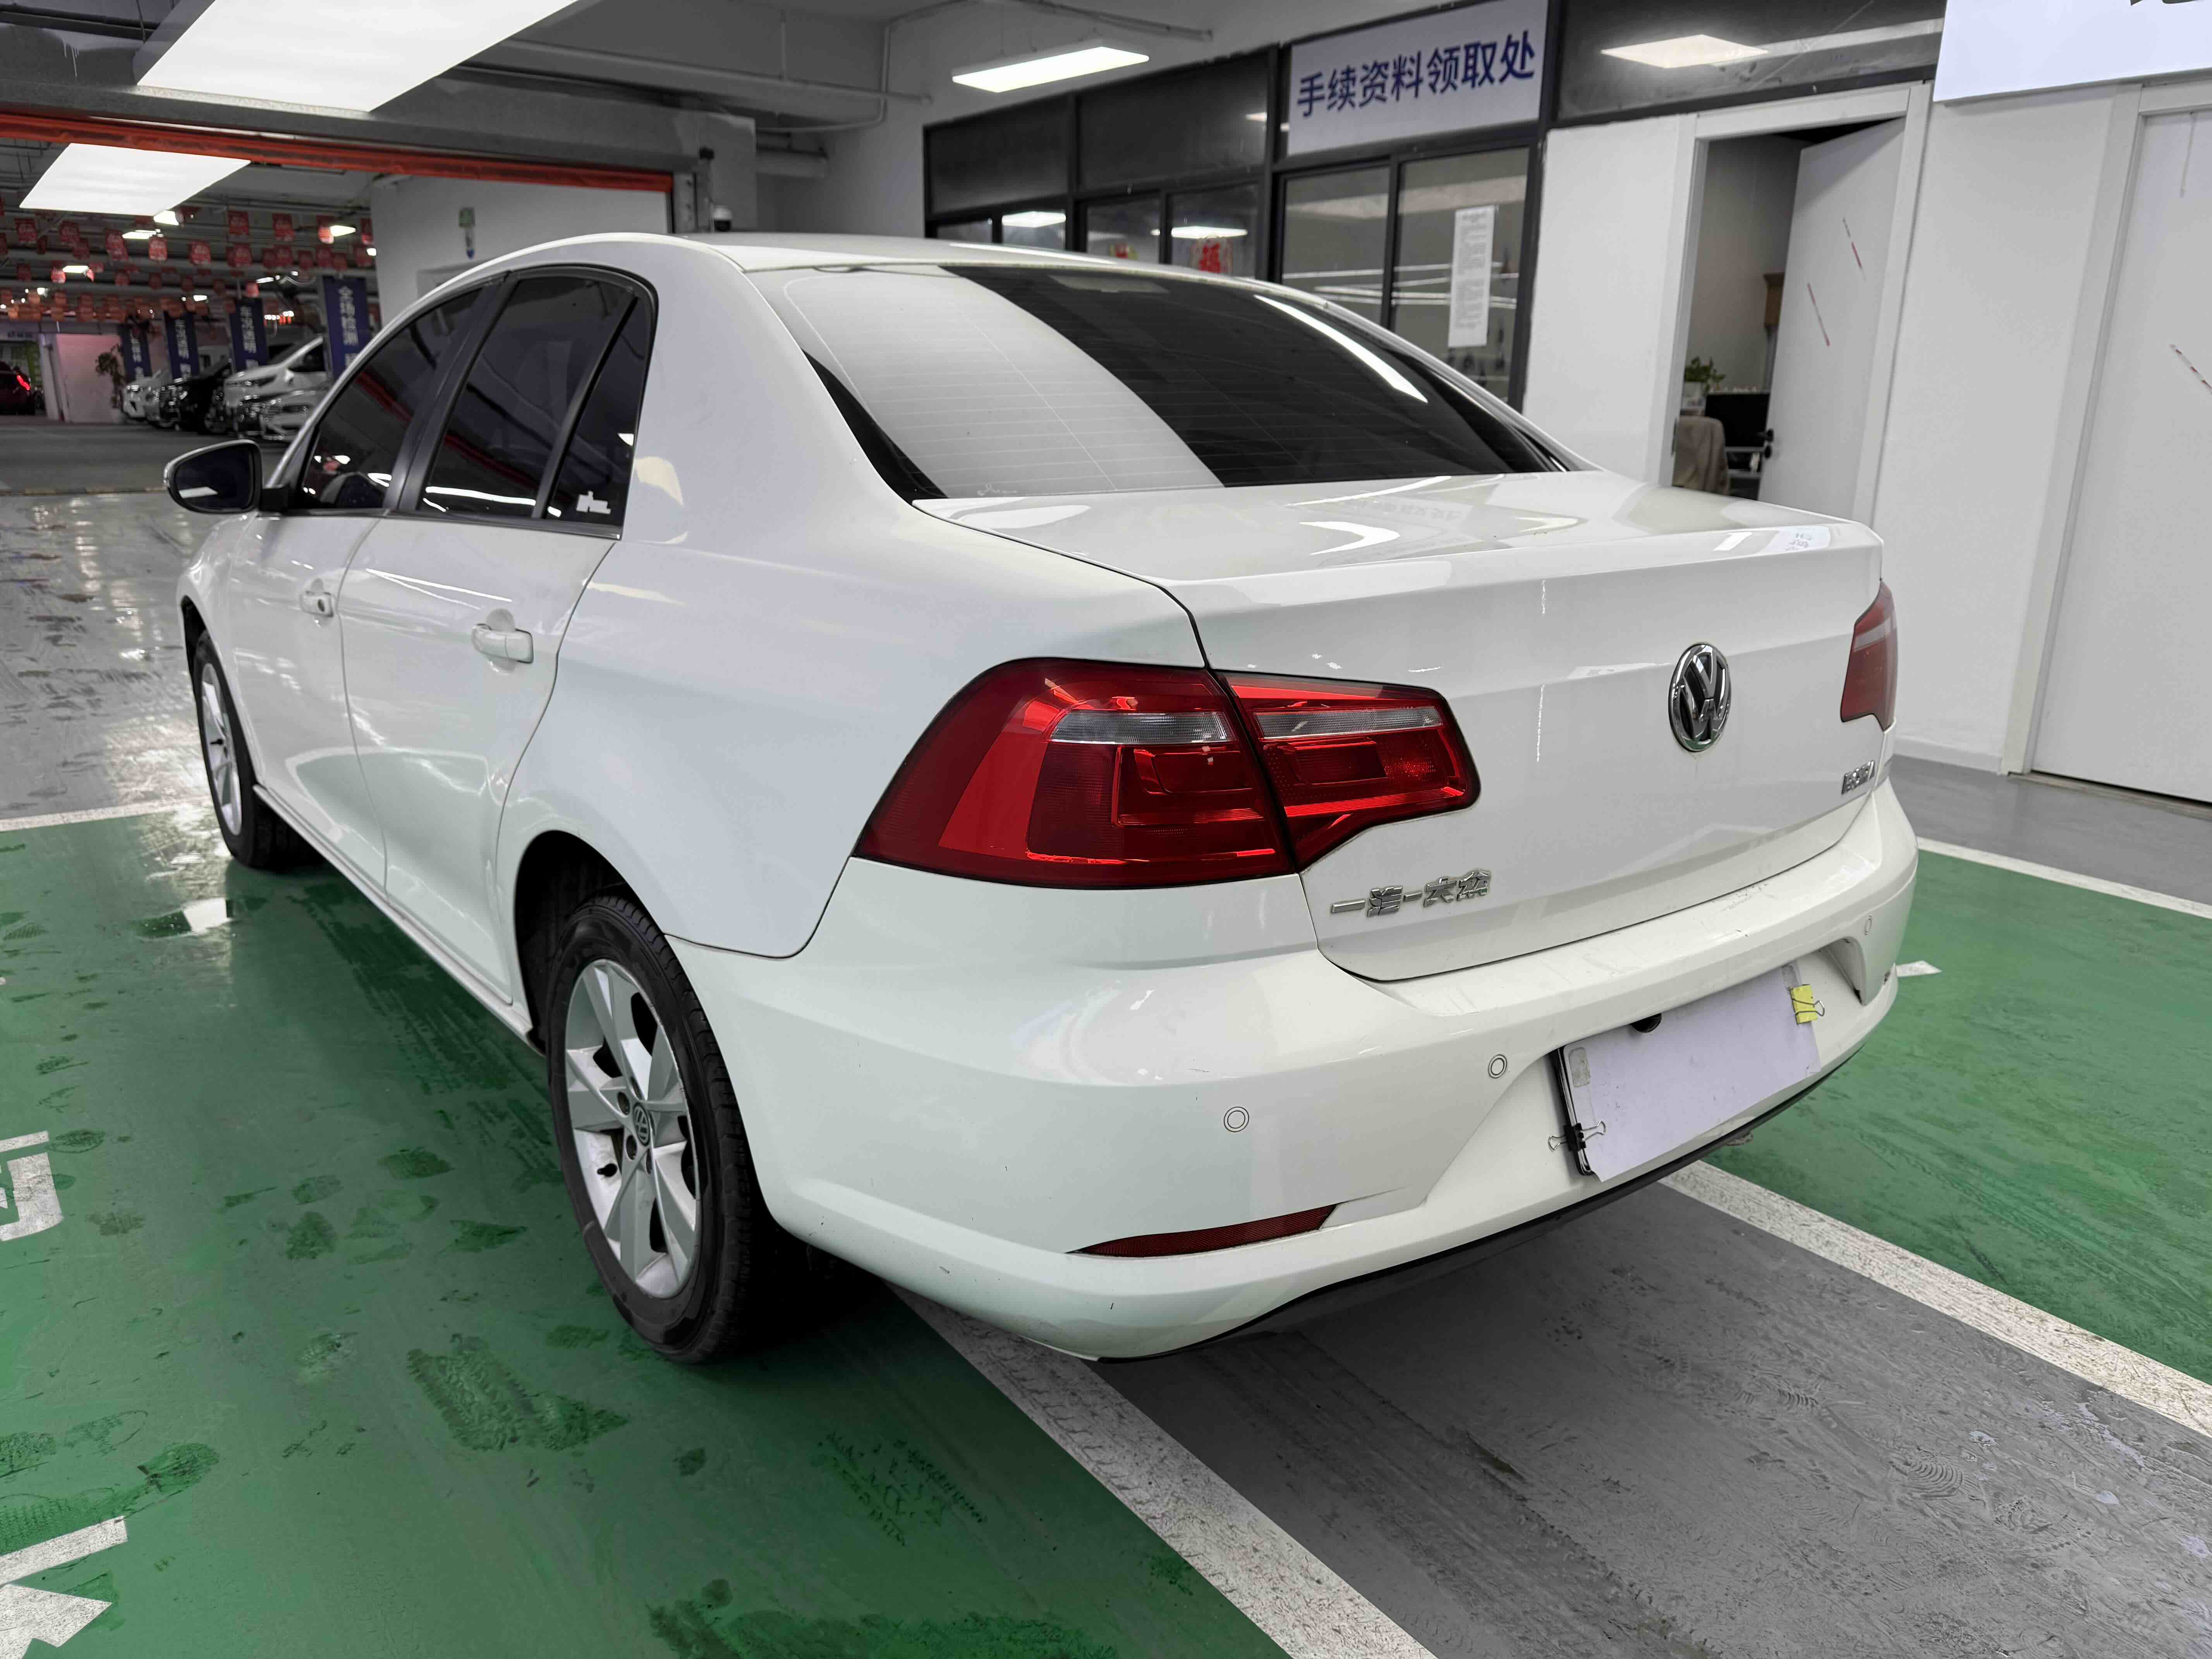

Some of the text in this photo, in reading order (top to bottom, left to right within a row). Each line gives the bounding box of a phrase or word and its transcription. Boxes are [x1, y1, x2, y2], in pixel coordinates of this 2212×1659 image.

[1297, 30, 1535, 118] 手续资料领取处
[1330, 869, 1491, 918] 一汽-大众
